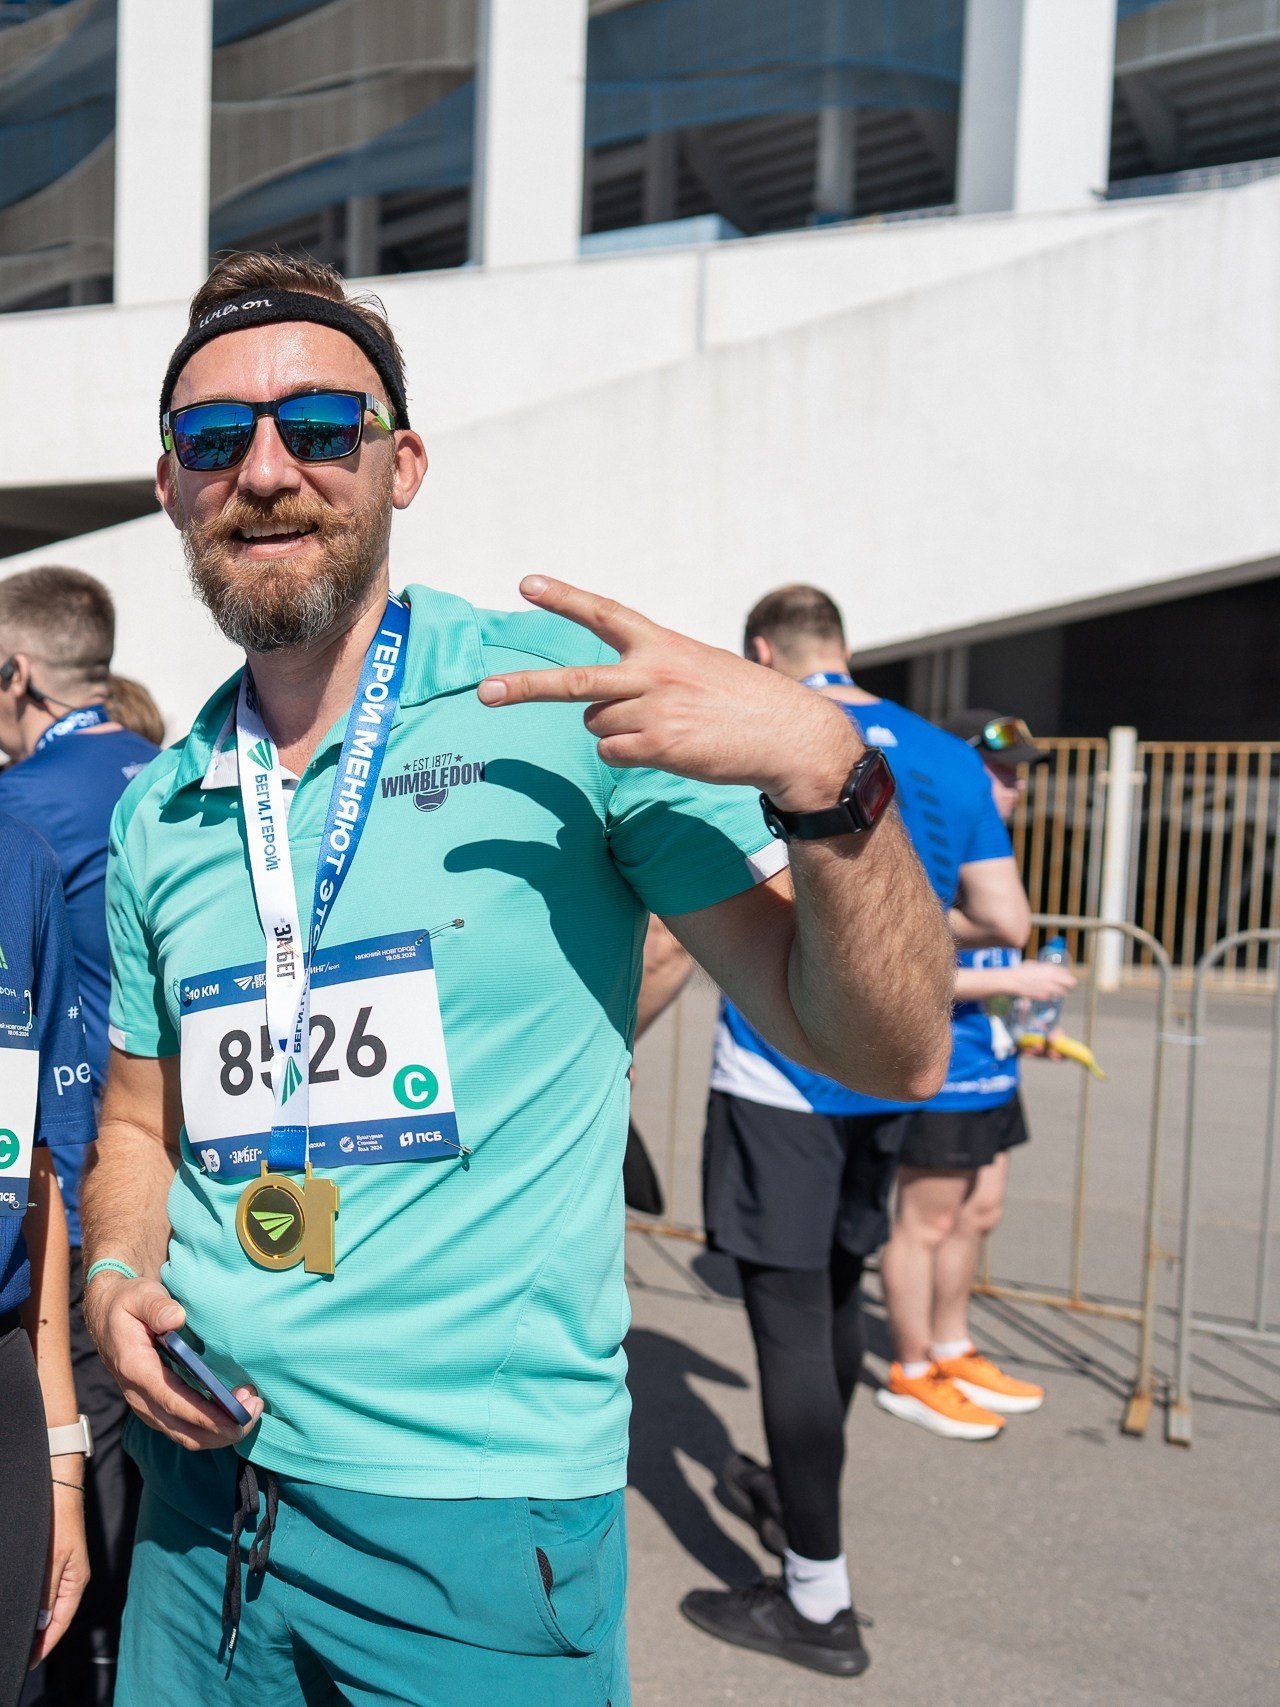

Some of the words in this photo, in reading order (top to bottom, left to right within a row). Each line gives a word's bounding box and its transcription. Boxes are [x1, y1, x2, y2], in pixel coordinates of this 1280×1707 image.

[359, 629, 402, 725] ГЕРОИ
[255, 773, 273, 818] БЕГИ,
[380, 761, 486, 799] WIMBLEDON
[325, 730, 378, 875] МЕНЯЮТ
[260, 813, 279, 871] ГЕРОЙ!
[355, 950, 381, 960] НИЖНИЙ
[382, 945, 416, 956] НОВГОРОД
[385, 951, 417, 961] 19.05.2024
[415, 1131, 442, 1143] ПСБ
